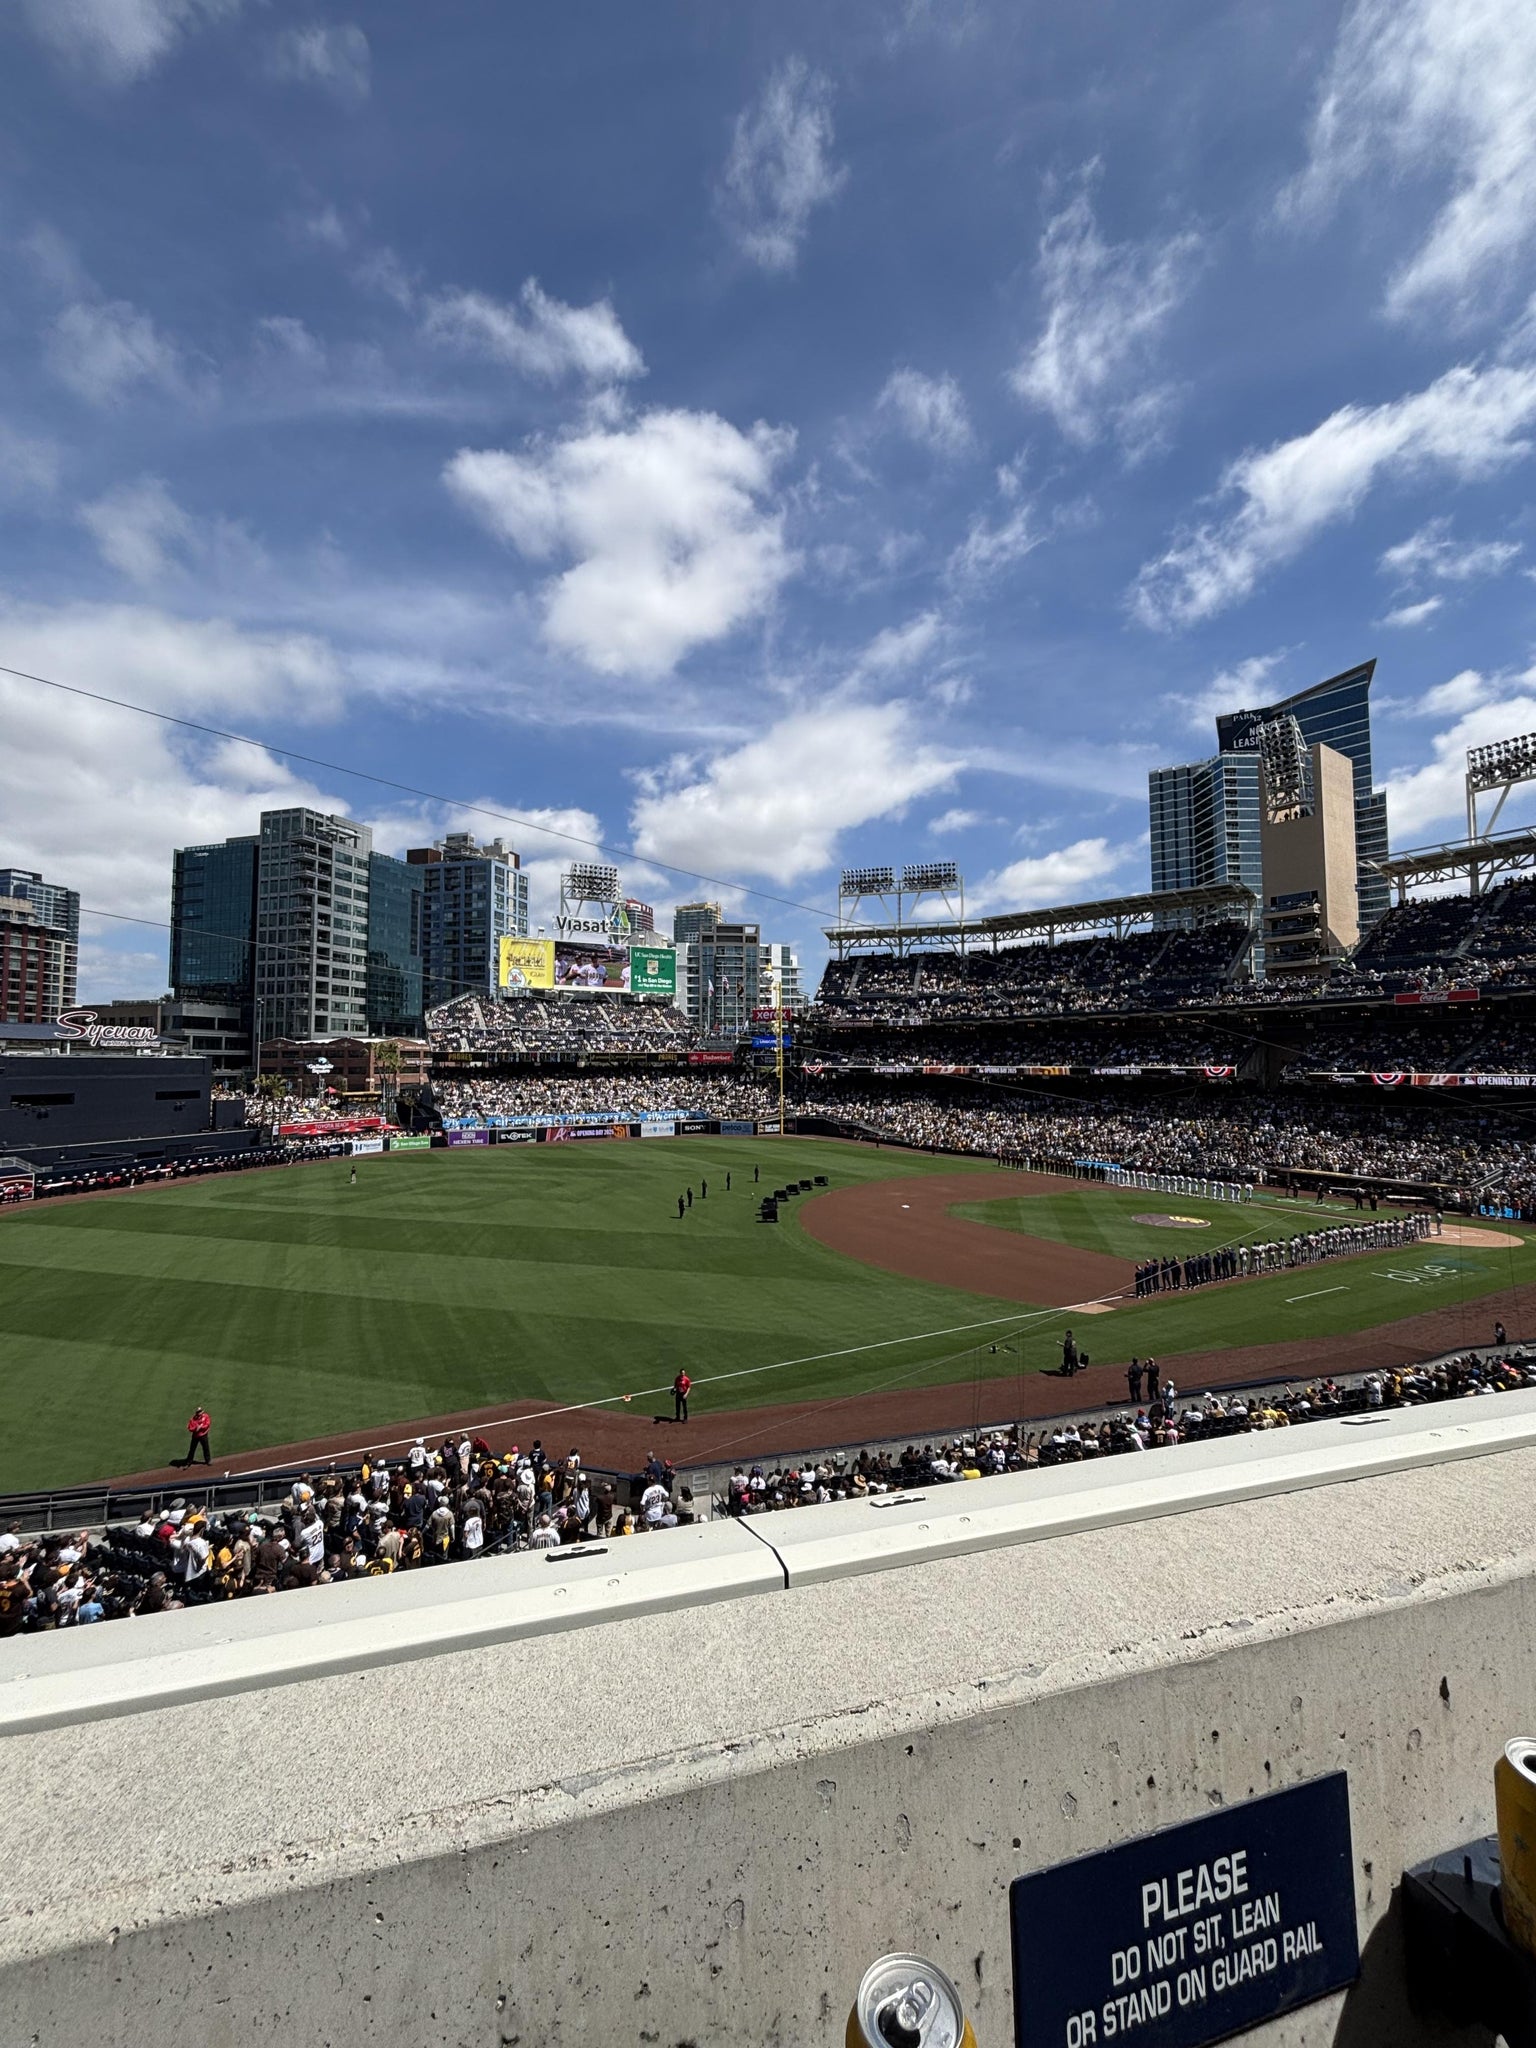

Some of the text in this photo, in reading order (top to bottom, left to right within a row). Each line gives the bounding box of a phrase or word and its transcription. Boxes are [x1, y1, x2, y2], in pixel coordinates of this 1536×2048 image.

[556, 915, 609, 934] Viasat
[658, 977, 672, 985] Diego
[54, 1010, 159, 1047] Sycuan
[1477, 1077, 1512, 1086] OPENING
[1514, 1077, 1530, 1086] DAY
[722, 1123, 742, 1131] petco
[1372, 1264, 1458, 1284] blue
[311, 1531, 323, 1546] 23
[1142, 1850, 1249, 1928] PLEASE
[1112, 1892, 1281, 1987] DO NOT SIT, LEAN
[1066, 1921, 1323, 2048] OR STAND ON GUARD RAIL
